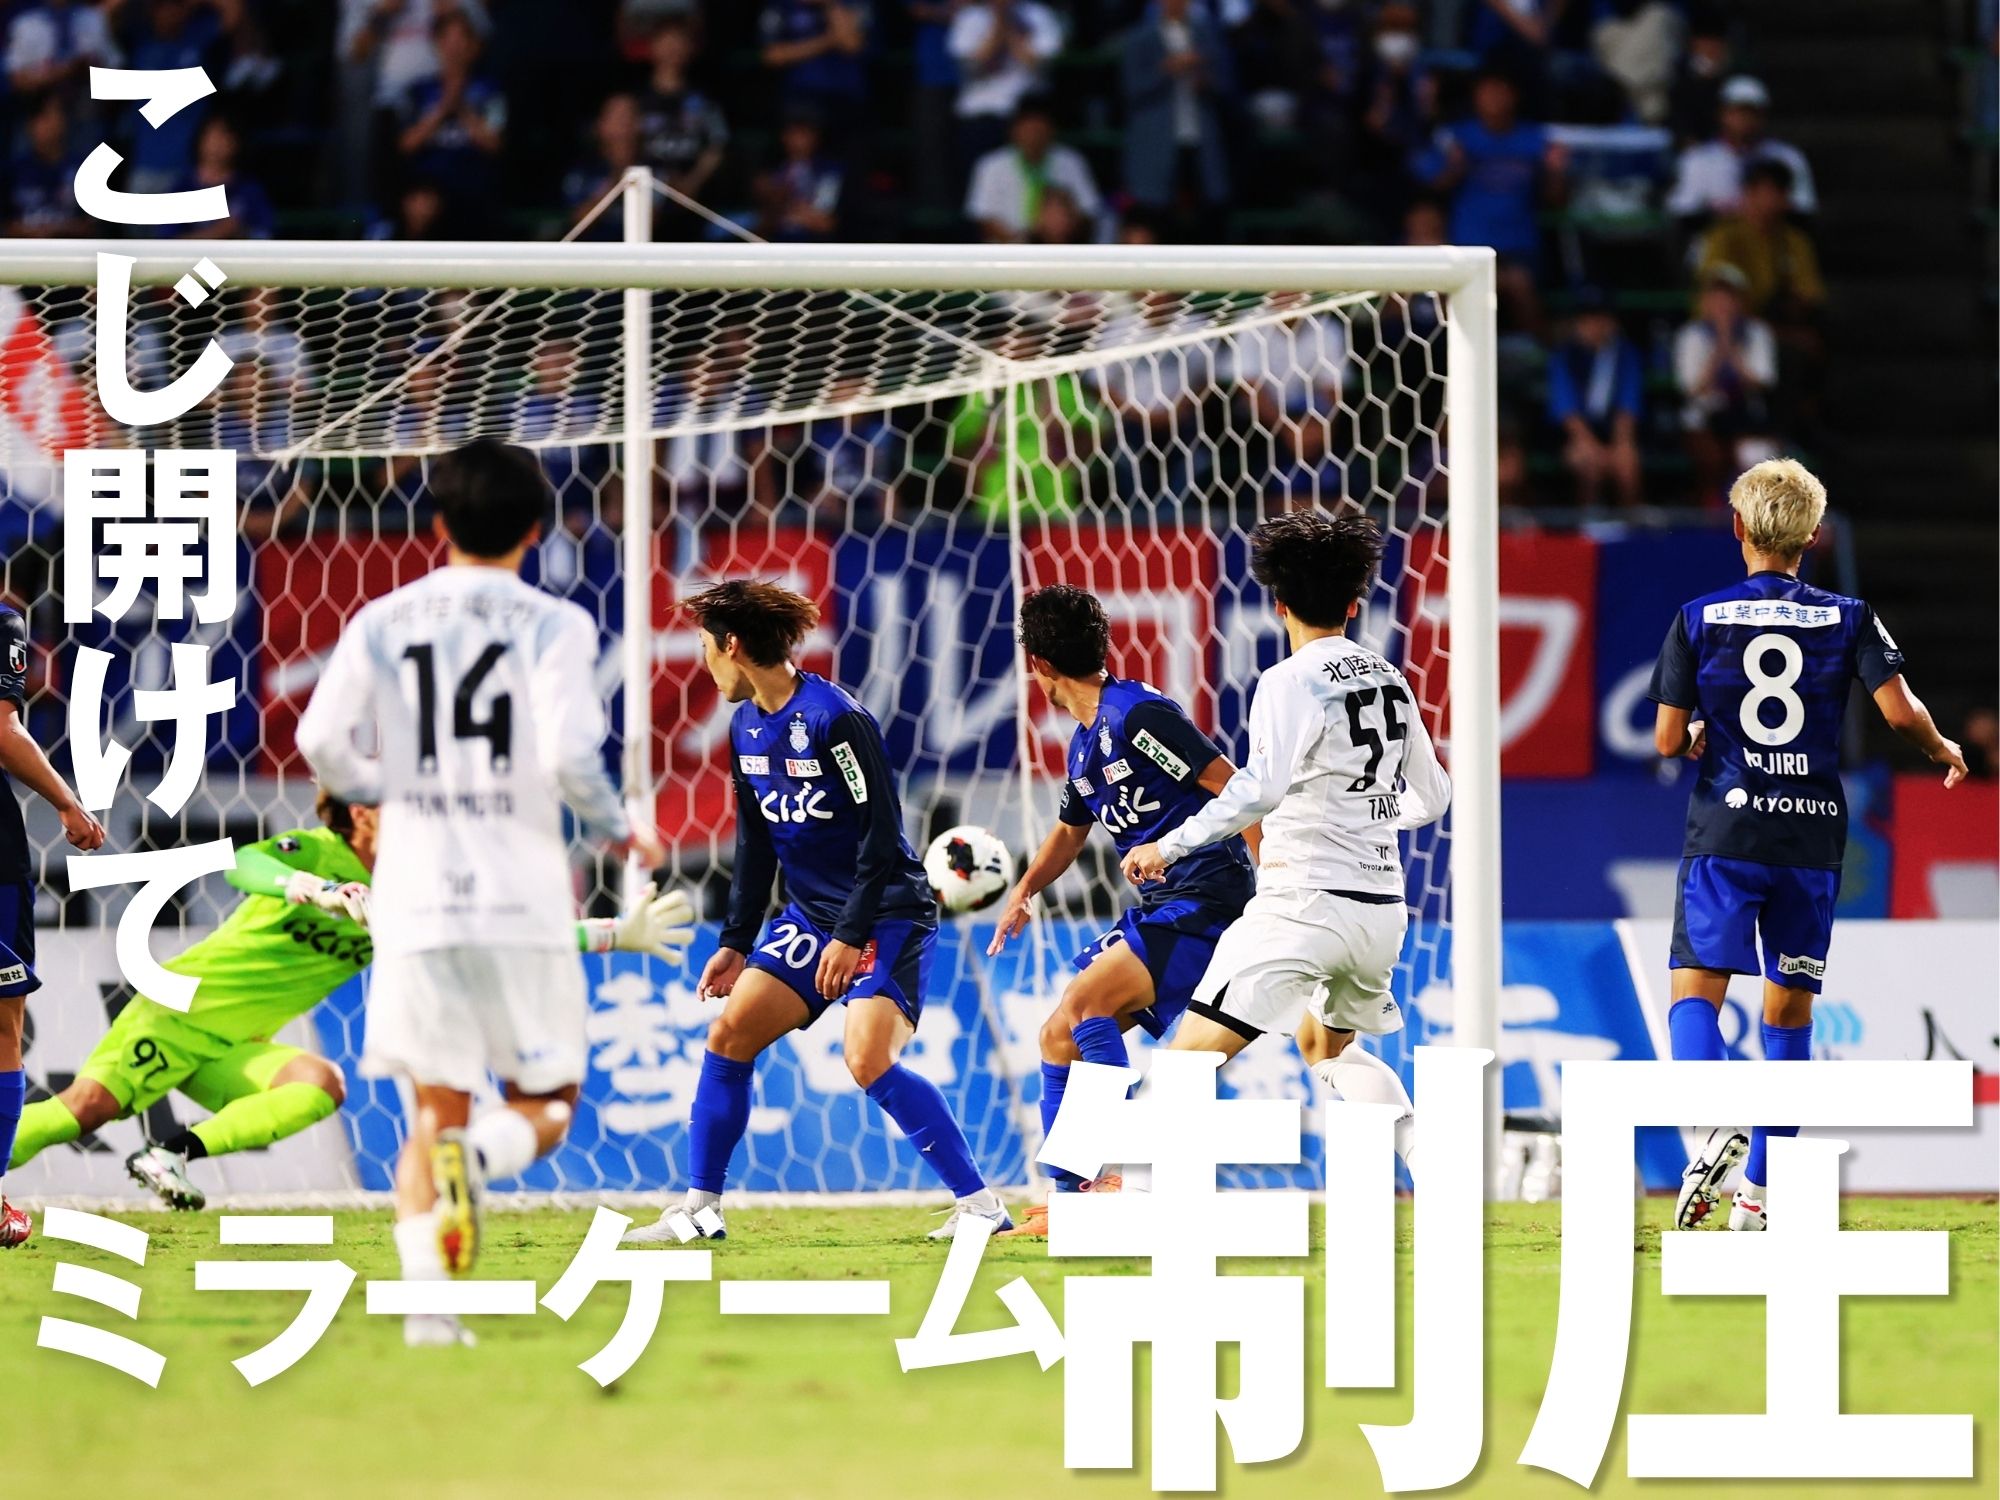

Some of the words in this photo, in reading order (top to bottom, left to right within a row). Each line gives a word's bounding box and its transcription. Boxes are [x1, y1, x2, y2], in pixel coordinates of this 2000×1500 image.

[1715, 604, 1831, 624] 山梨中央銀行
[1322, 654, 1403, 683] 北陸電
[1739, 633, 1805, 746] 8
[403, 642, 514, 775] 14
[1345, 684, 1410, 792] 55
[754, 782, 834, 824] くばく
[1092, 785, 1160, 834] くばく
[1752, 795, 1838, 816] KYOKUYO
[760, 924, 818, 969] 20
[130, 1037, 169, 1087] 97
